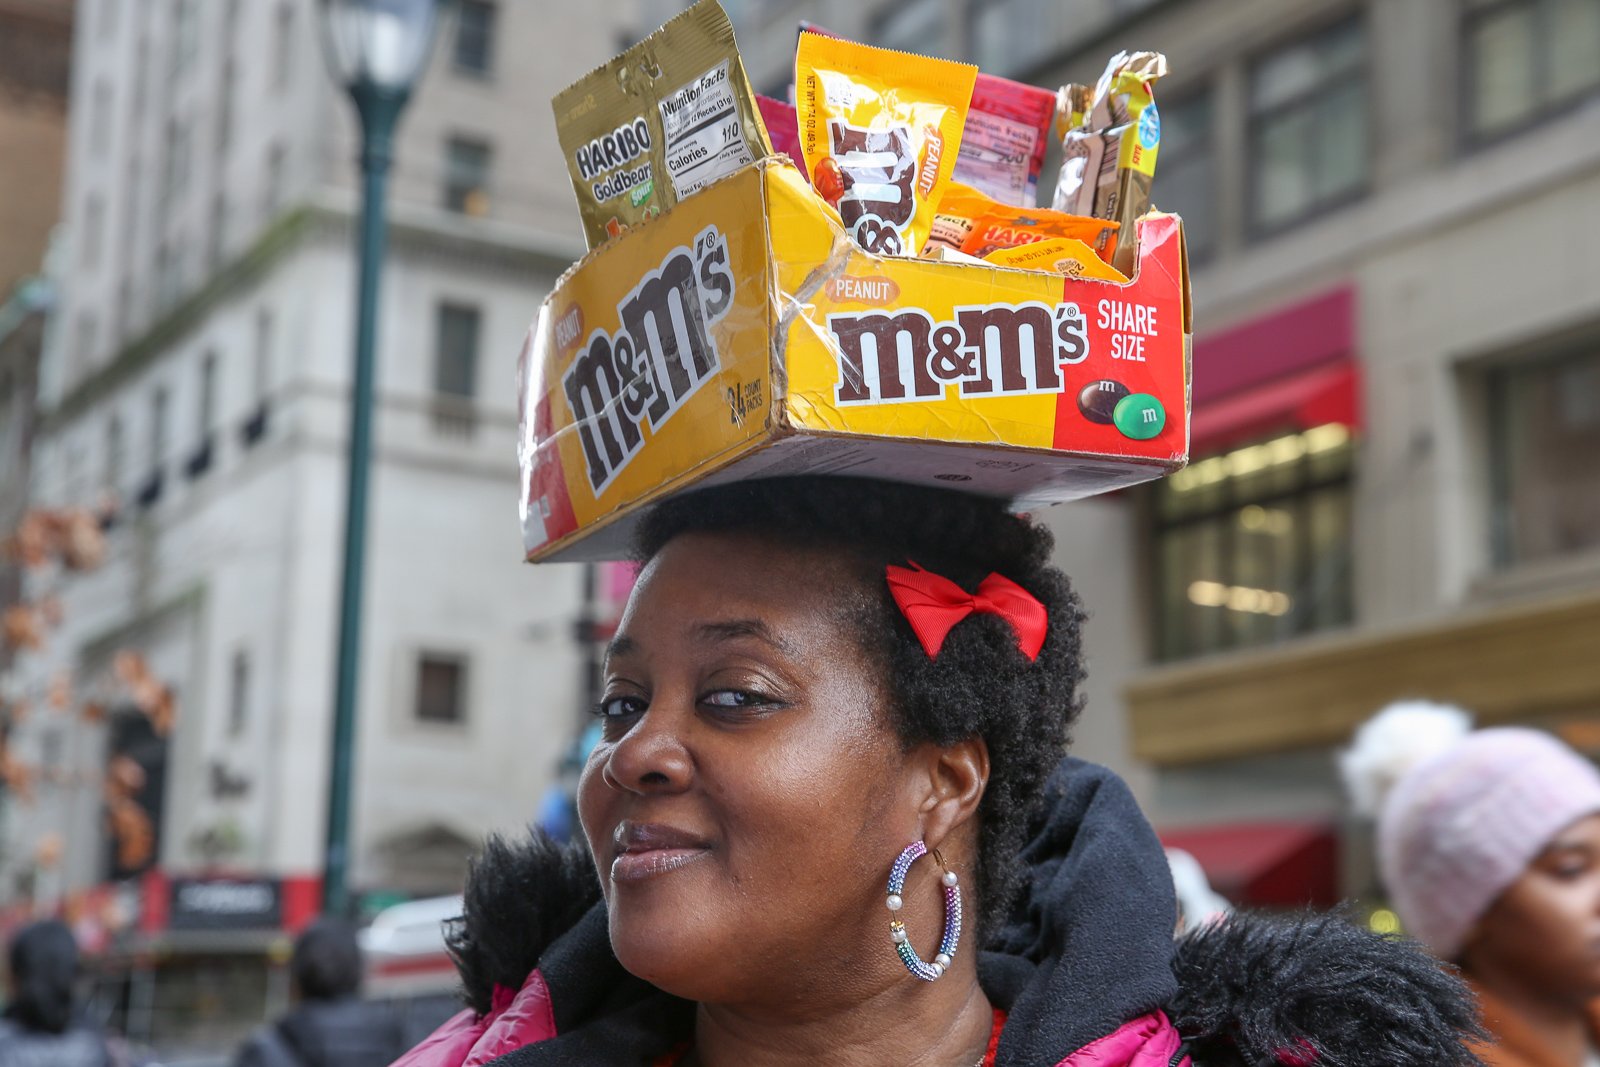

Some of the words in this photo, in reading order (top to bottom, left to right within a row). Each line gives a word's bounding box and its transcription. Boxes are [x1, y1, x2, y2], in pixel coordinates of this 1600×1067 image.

[662, 87, 701, 117] Nutrition
[701, 68, 725, 93] Facts
[697, 105, 716, 120] Pieces
[716, 95, 733, 110] (31g)
[722, 121, 739, 144] 110
[576, 118, 651, 179] HARIBO
[669, 147, 708, 171] Calories
[919, 133, 941, 193] PEANUT
[681, 185, 693, 196] Total
[693, 182, 702, 190] Fat
[836, 279, 889, 300] PEANUT
[555, 308, 581, 347] PEANUT
[1097, 299, 1158, 336] SHARE
[1110, 333, 1146, 362] SIZE
[1099, 380, 1115, 393] m
[727, 383, 746, 425] 24
[1142, 408, 1158, 423] m
